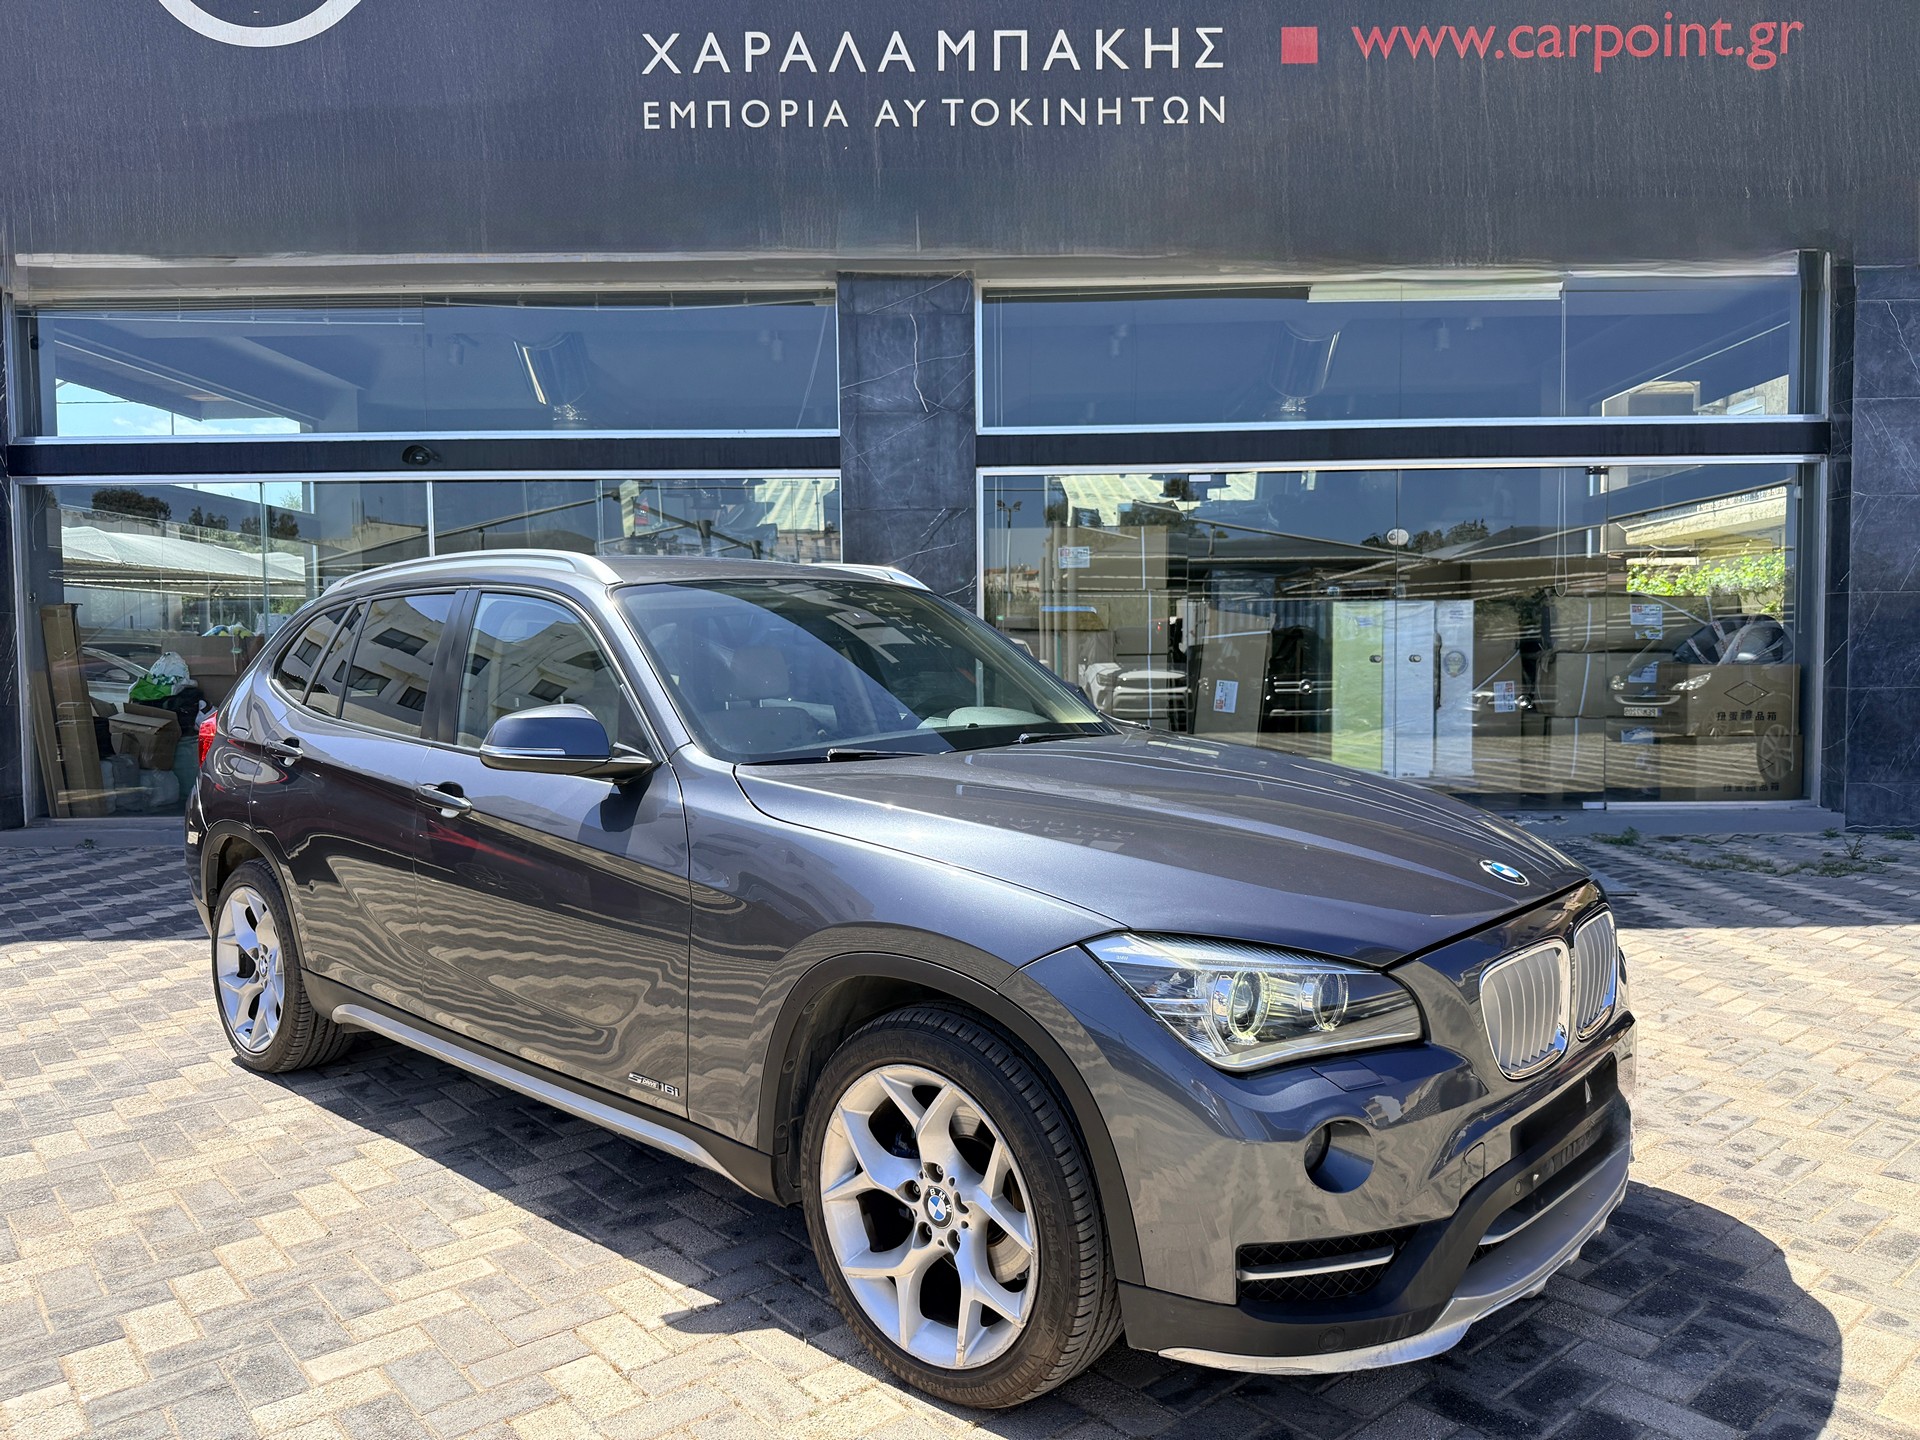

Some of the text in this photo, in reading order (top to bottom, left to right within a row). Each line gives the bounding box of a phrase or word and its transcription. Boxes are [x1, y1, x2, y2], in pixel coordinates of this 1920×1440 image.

[1351, 11, 1804, 73] www.carpoint.gr
[643, 99, 849, 130] ΕΜΠΟΡΙΑ
[929, 1187, 953, 1214] BMW
